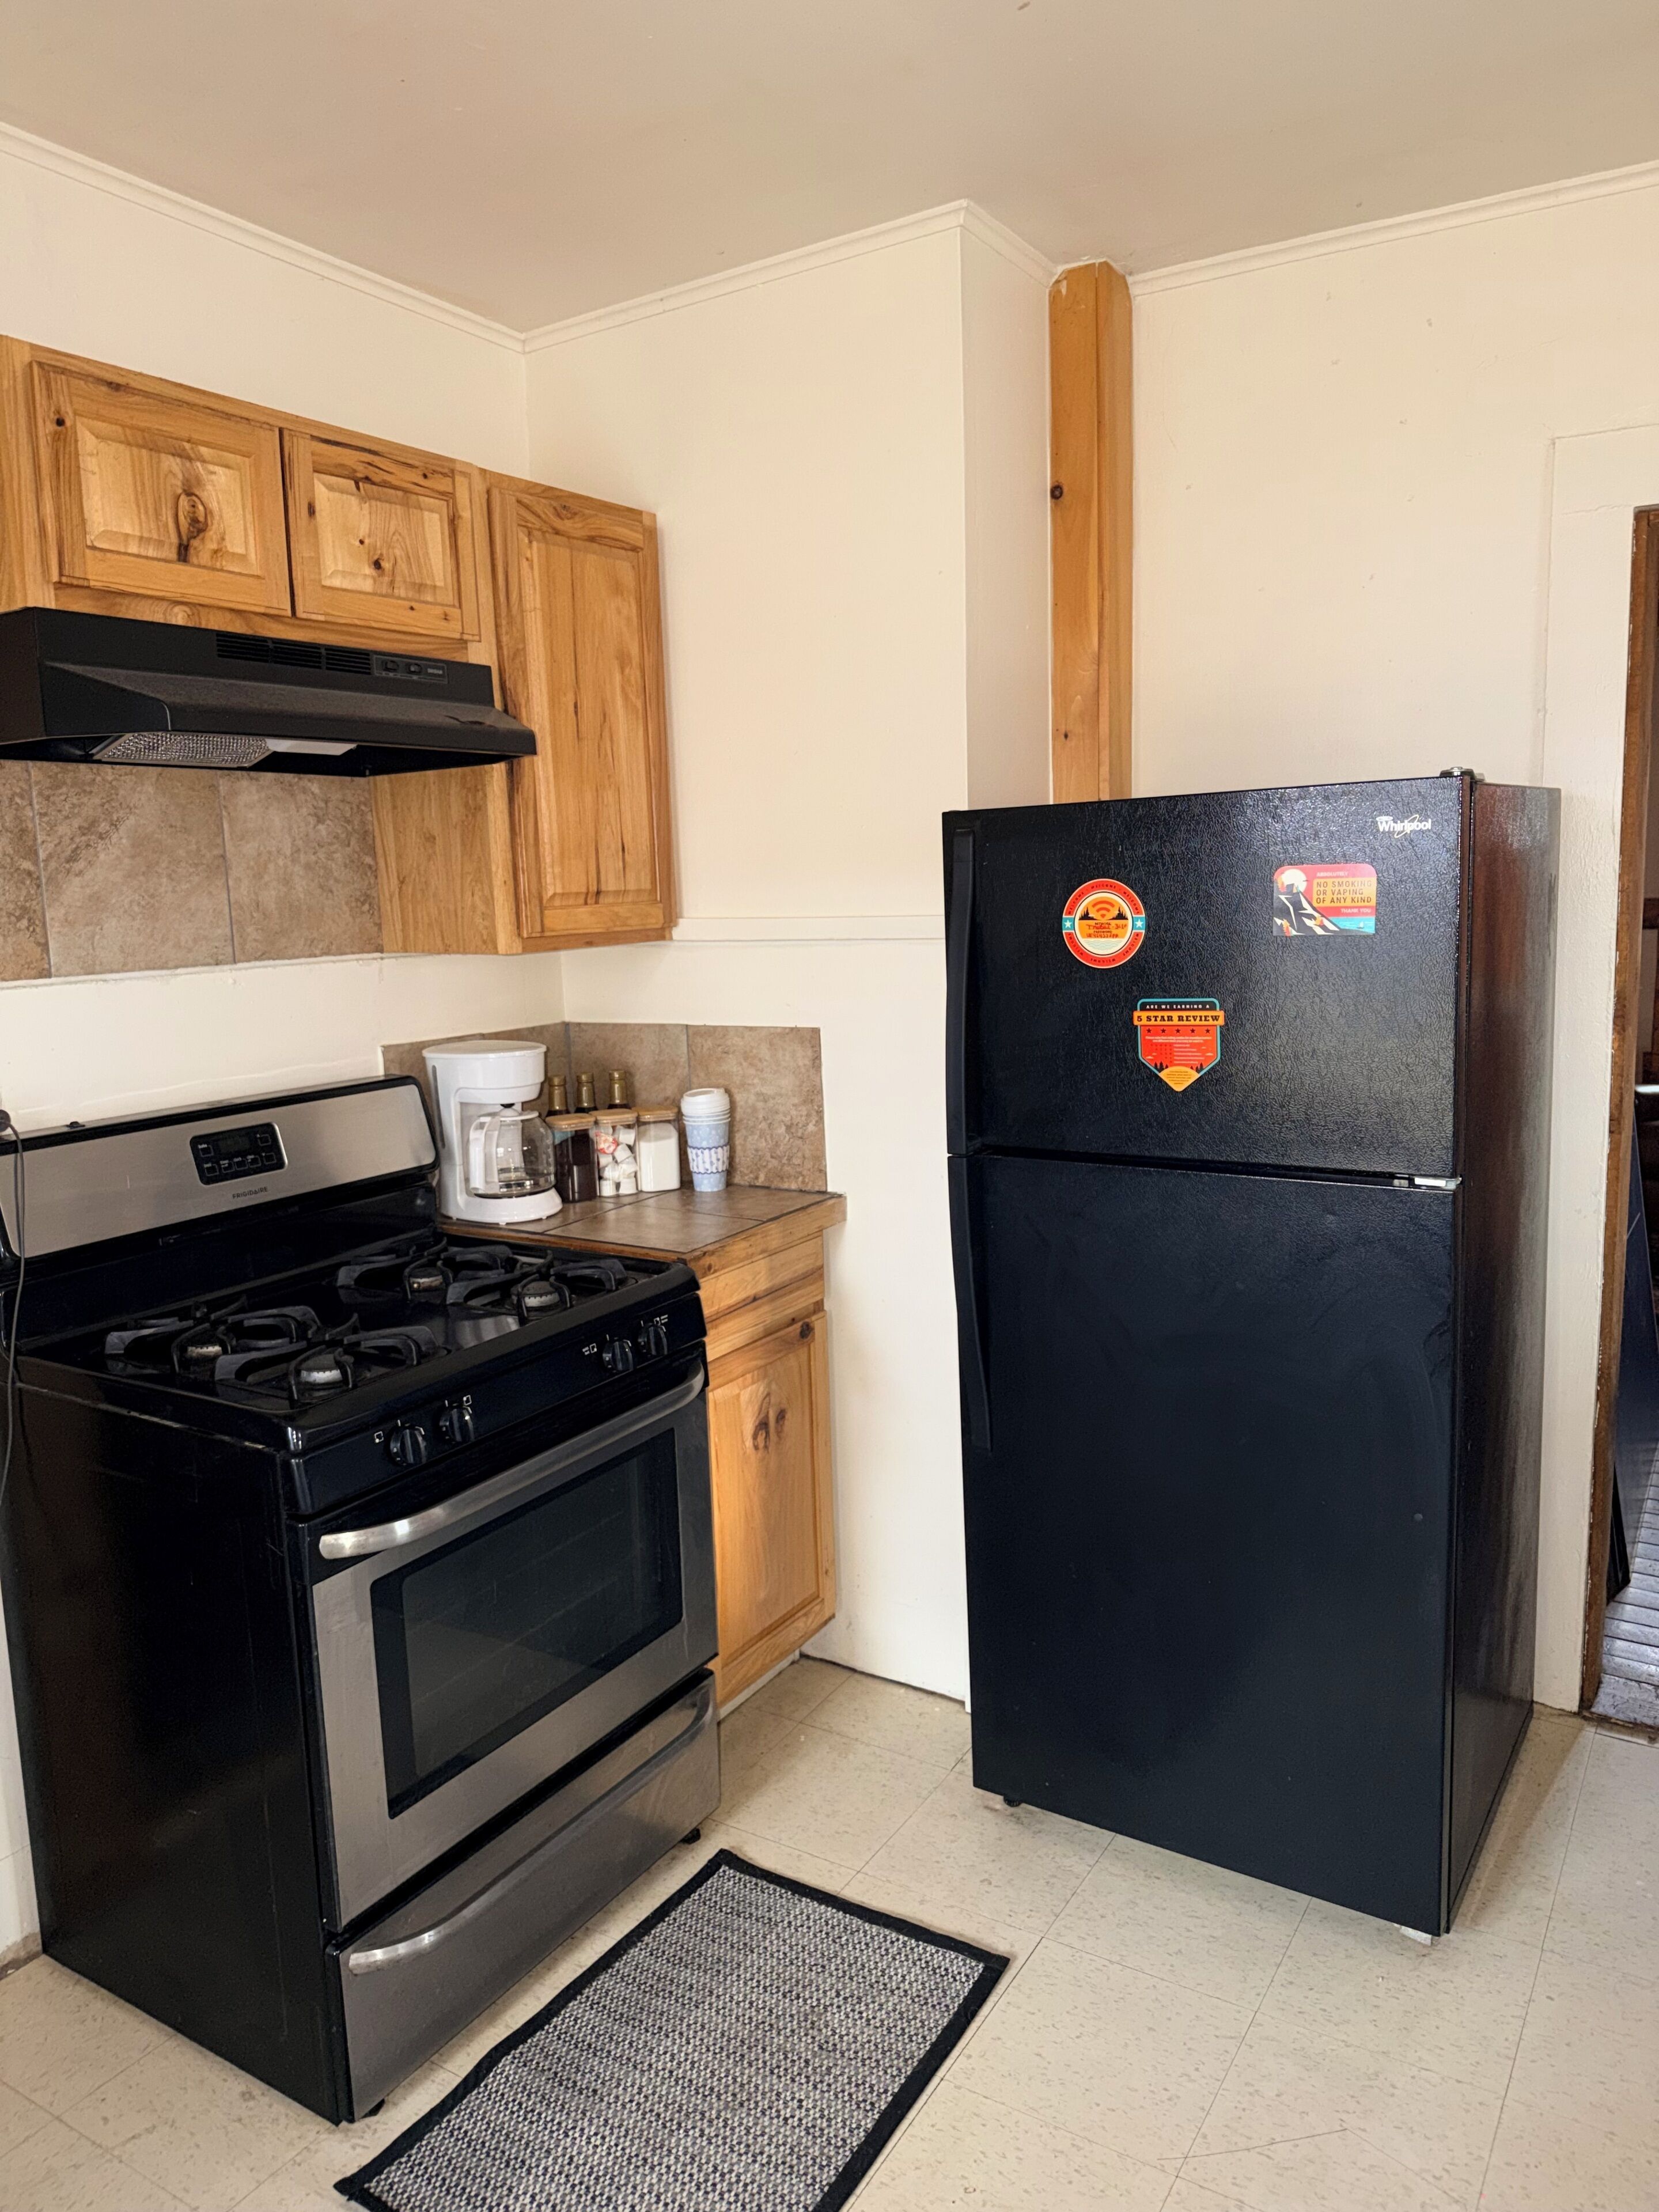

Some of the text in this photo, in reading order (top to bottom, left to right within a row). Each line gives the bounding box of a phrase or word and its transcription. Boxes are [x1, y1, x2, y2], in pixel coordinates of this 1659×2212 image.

[1377, 818, 1432, 834] Whirlpool
[1331, 888, 1363, 896] VAPING
[232, 1186, 268, 1199] FRIGIDAIRE
